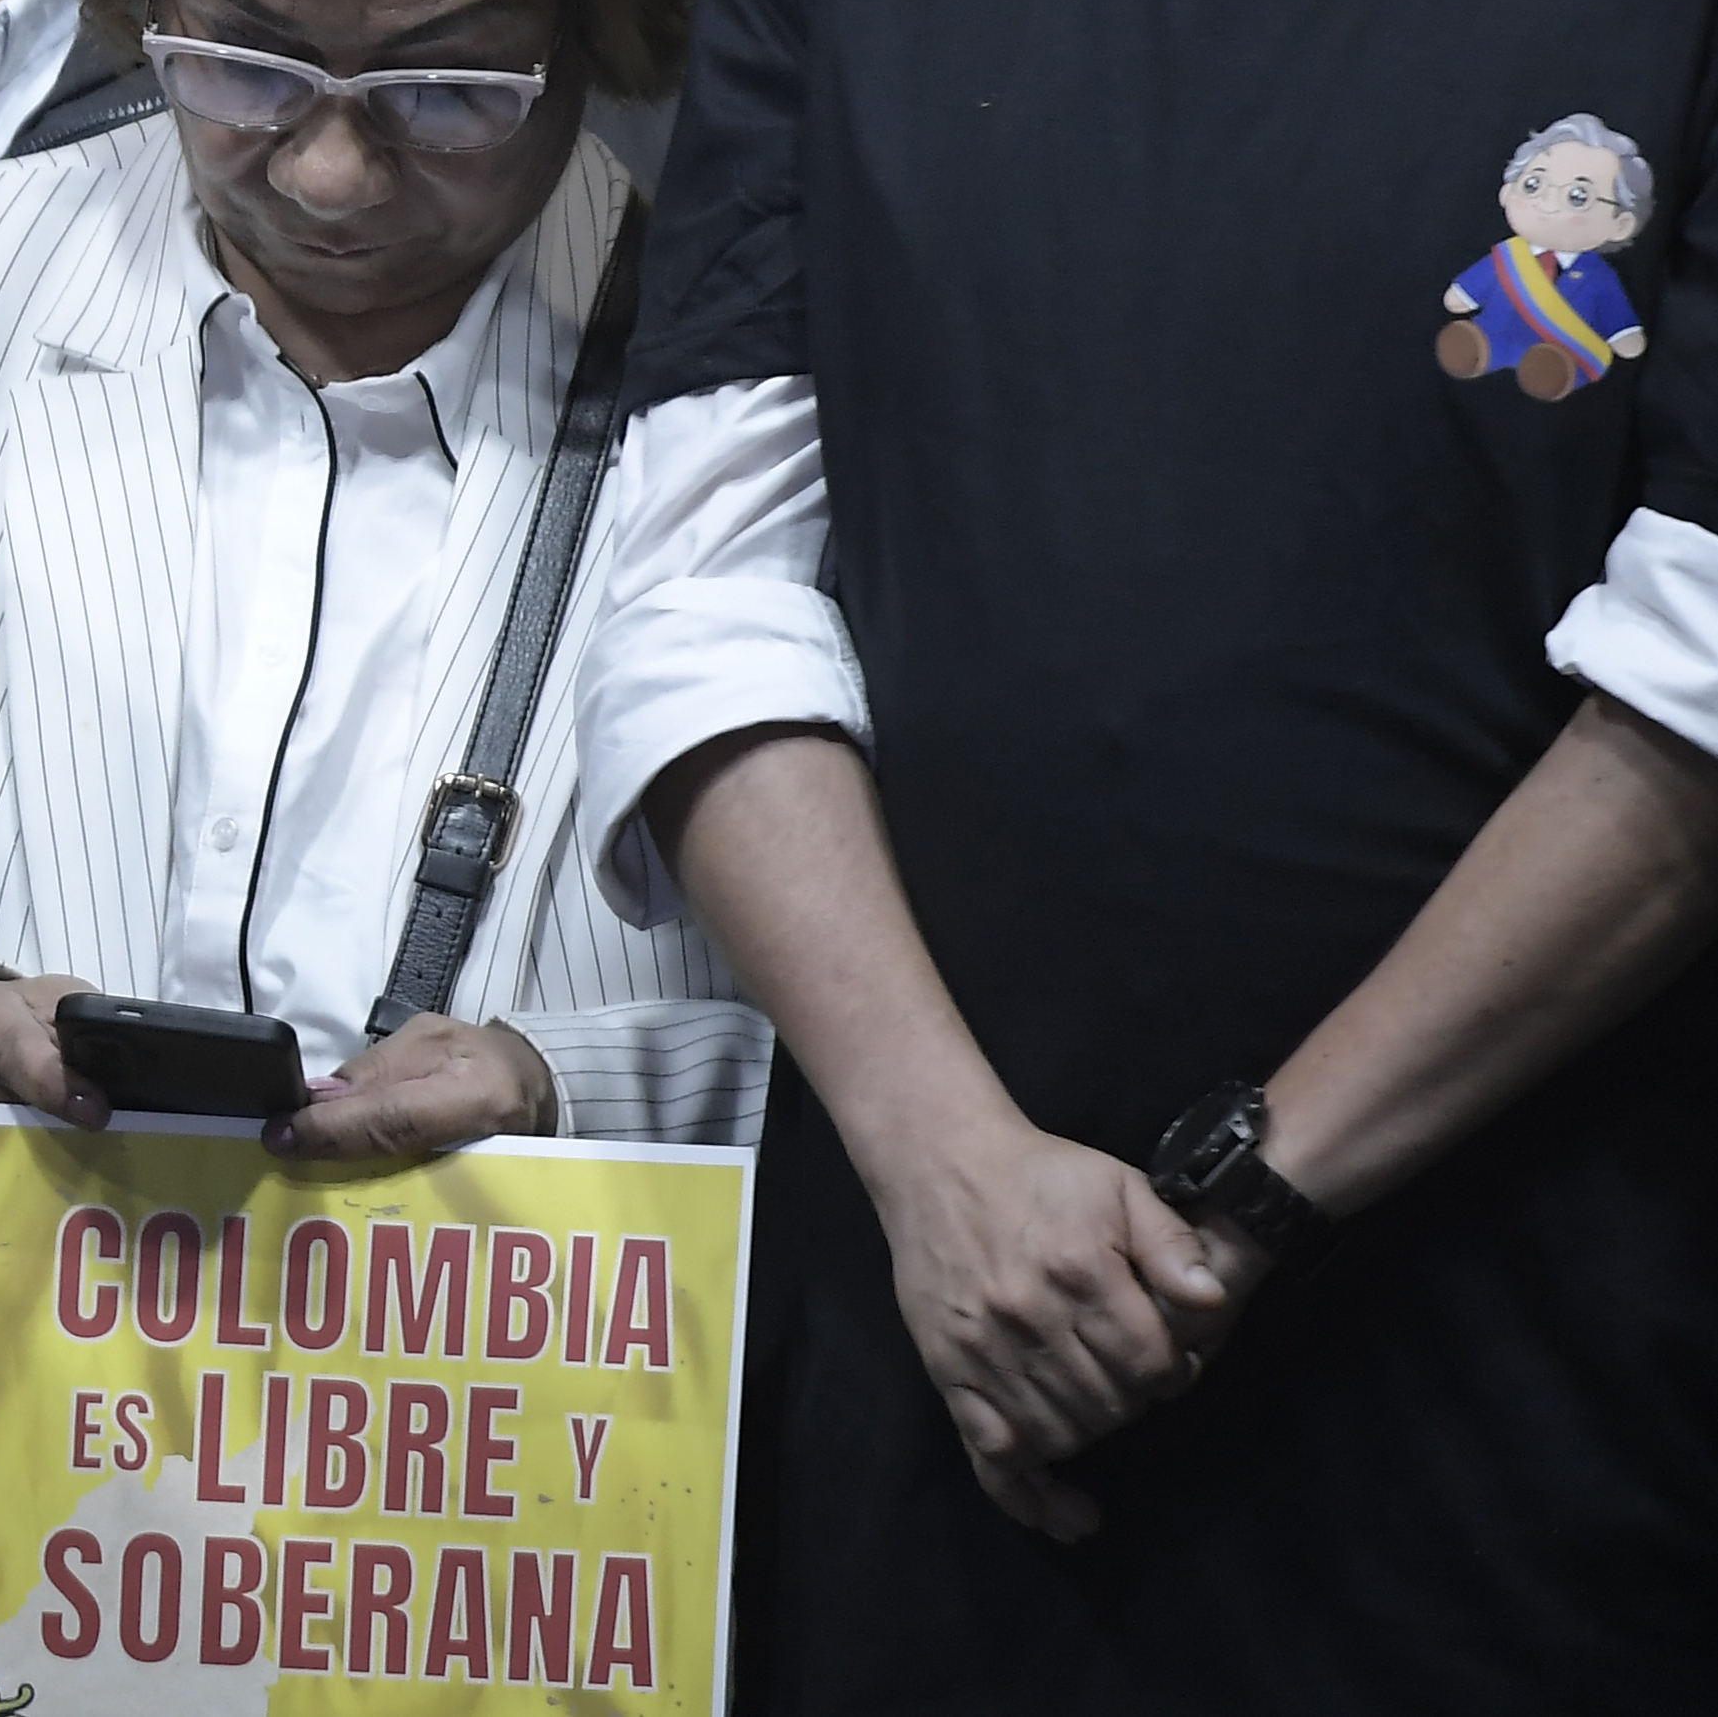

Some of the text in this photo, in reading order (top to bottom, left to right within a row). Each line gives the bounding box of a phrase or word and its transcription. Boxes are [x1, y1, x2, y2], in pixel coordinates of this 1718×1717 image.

[57, 1205, 672, 1369] COLOMBIA
[72, 1372, 608, 1519] ES LIBRE Y
[40, 1527, 655, 1689] SOBERANA
